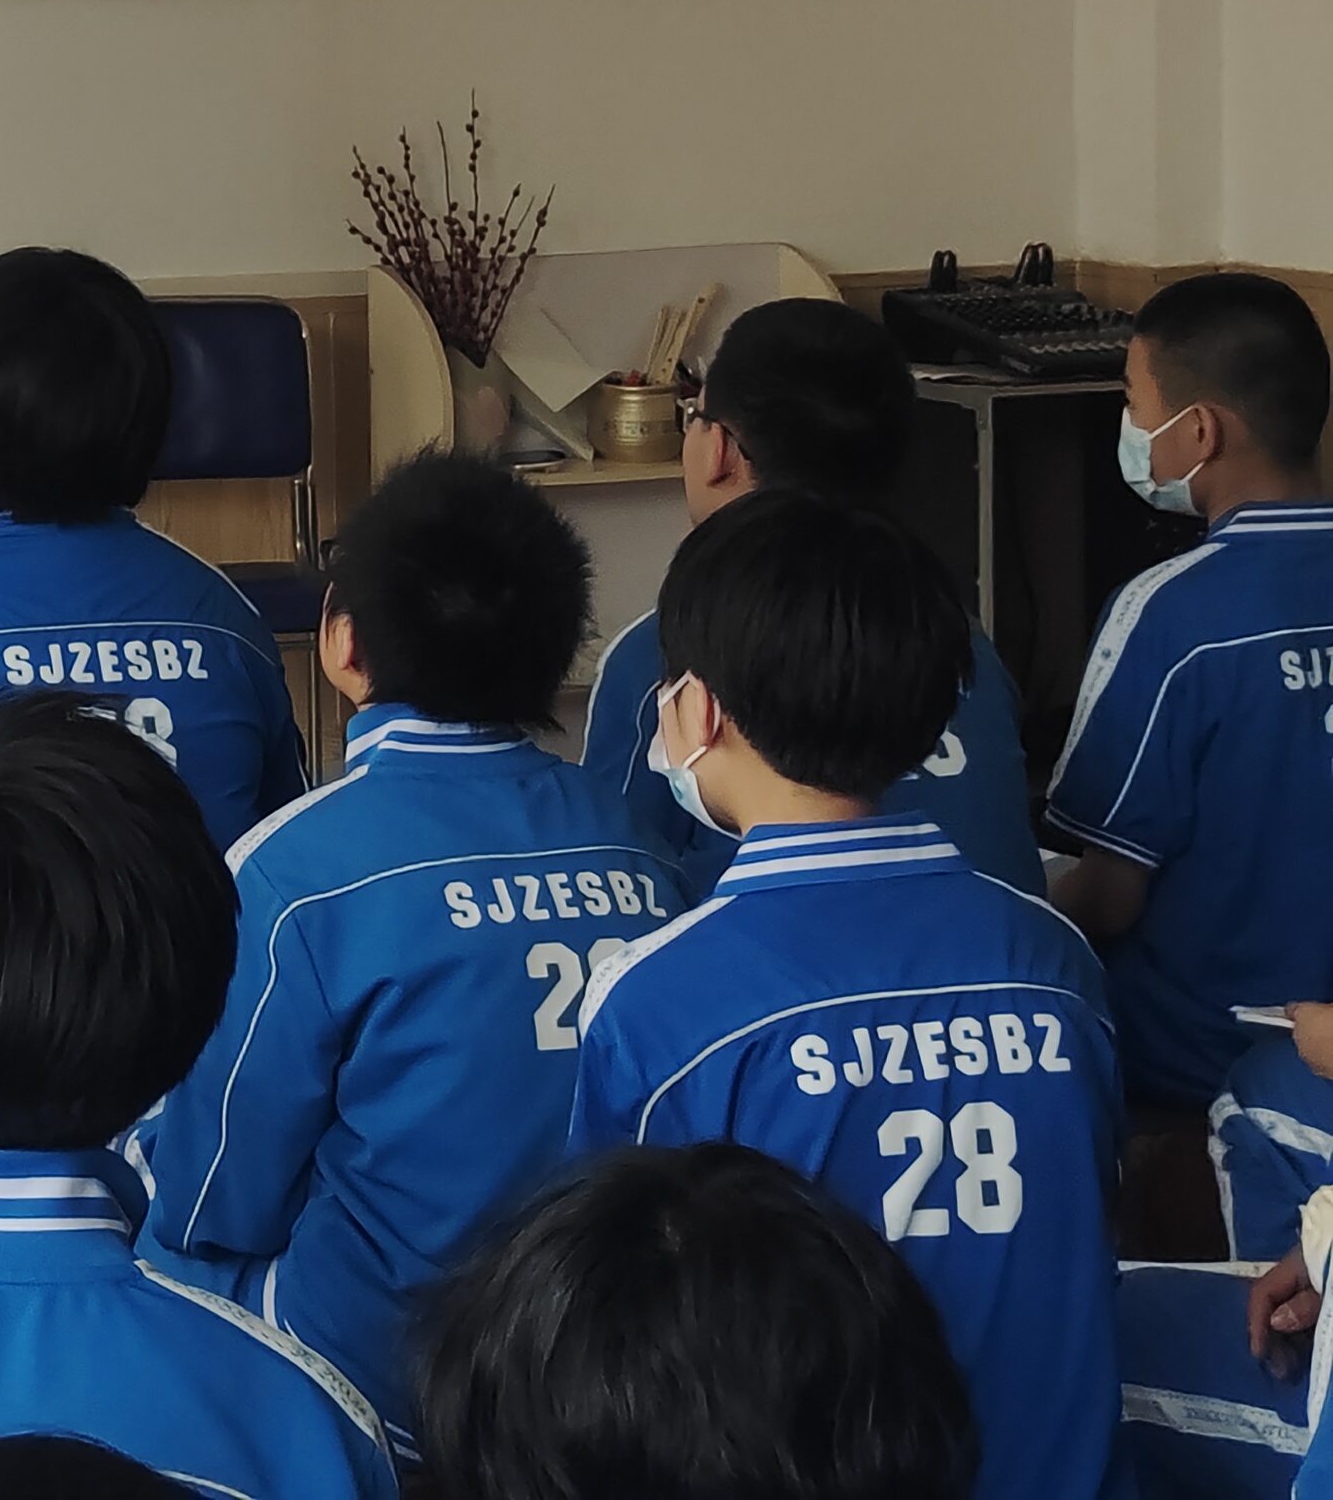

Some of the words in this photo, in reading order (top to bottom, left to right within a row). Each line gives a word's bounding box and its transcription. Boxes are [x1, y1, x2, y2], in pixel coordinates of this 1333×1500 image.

[3, 639, 209, 686] SJZESBZ
[1280, 647, 1333, 690] SJ
[444, 869, 667, 930] SJZESBZ
[791, 1012, 1072, 1096] SJZESBZ
[877, 1102, 1024, 1242] 28
